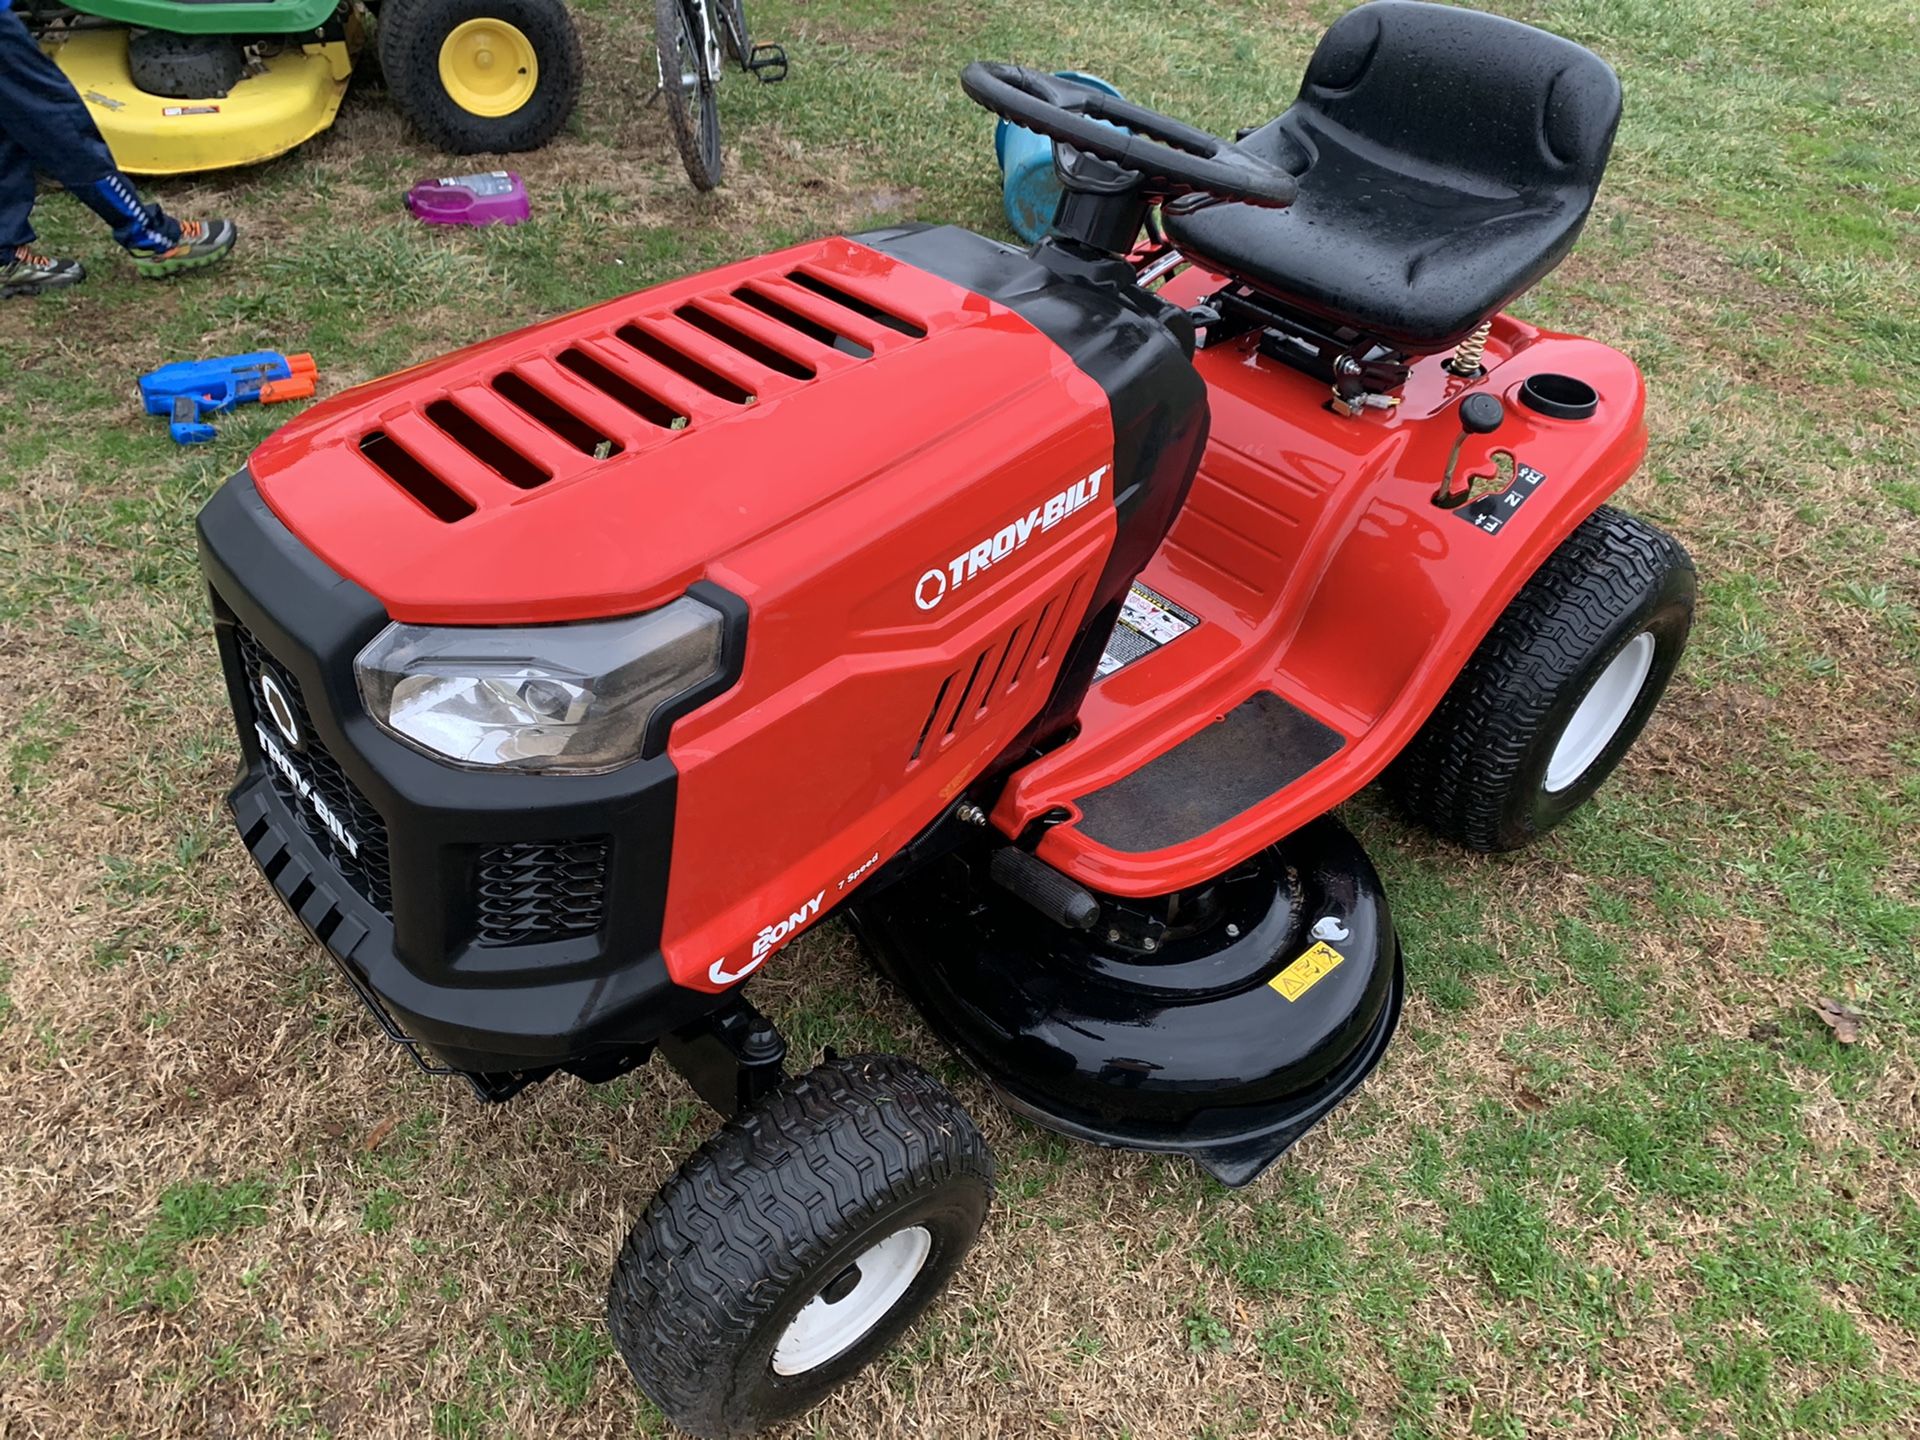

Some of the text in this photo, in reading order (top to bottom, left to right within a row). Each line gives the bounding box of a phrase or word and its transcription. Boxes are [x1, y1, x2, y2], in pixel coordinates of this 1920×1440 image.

[1525, 473, 1541, 485] R
[1504, 493, 1520, 507] N
[948, 465, 1106, 590] TROY-BILT
[1483, 522, 1498, 533] F
[752, 889, 825, 958] PONY
[847, 853, 879, 882] Speed
